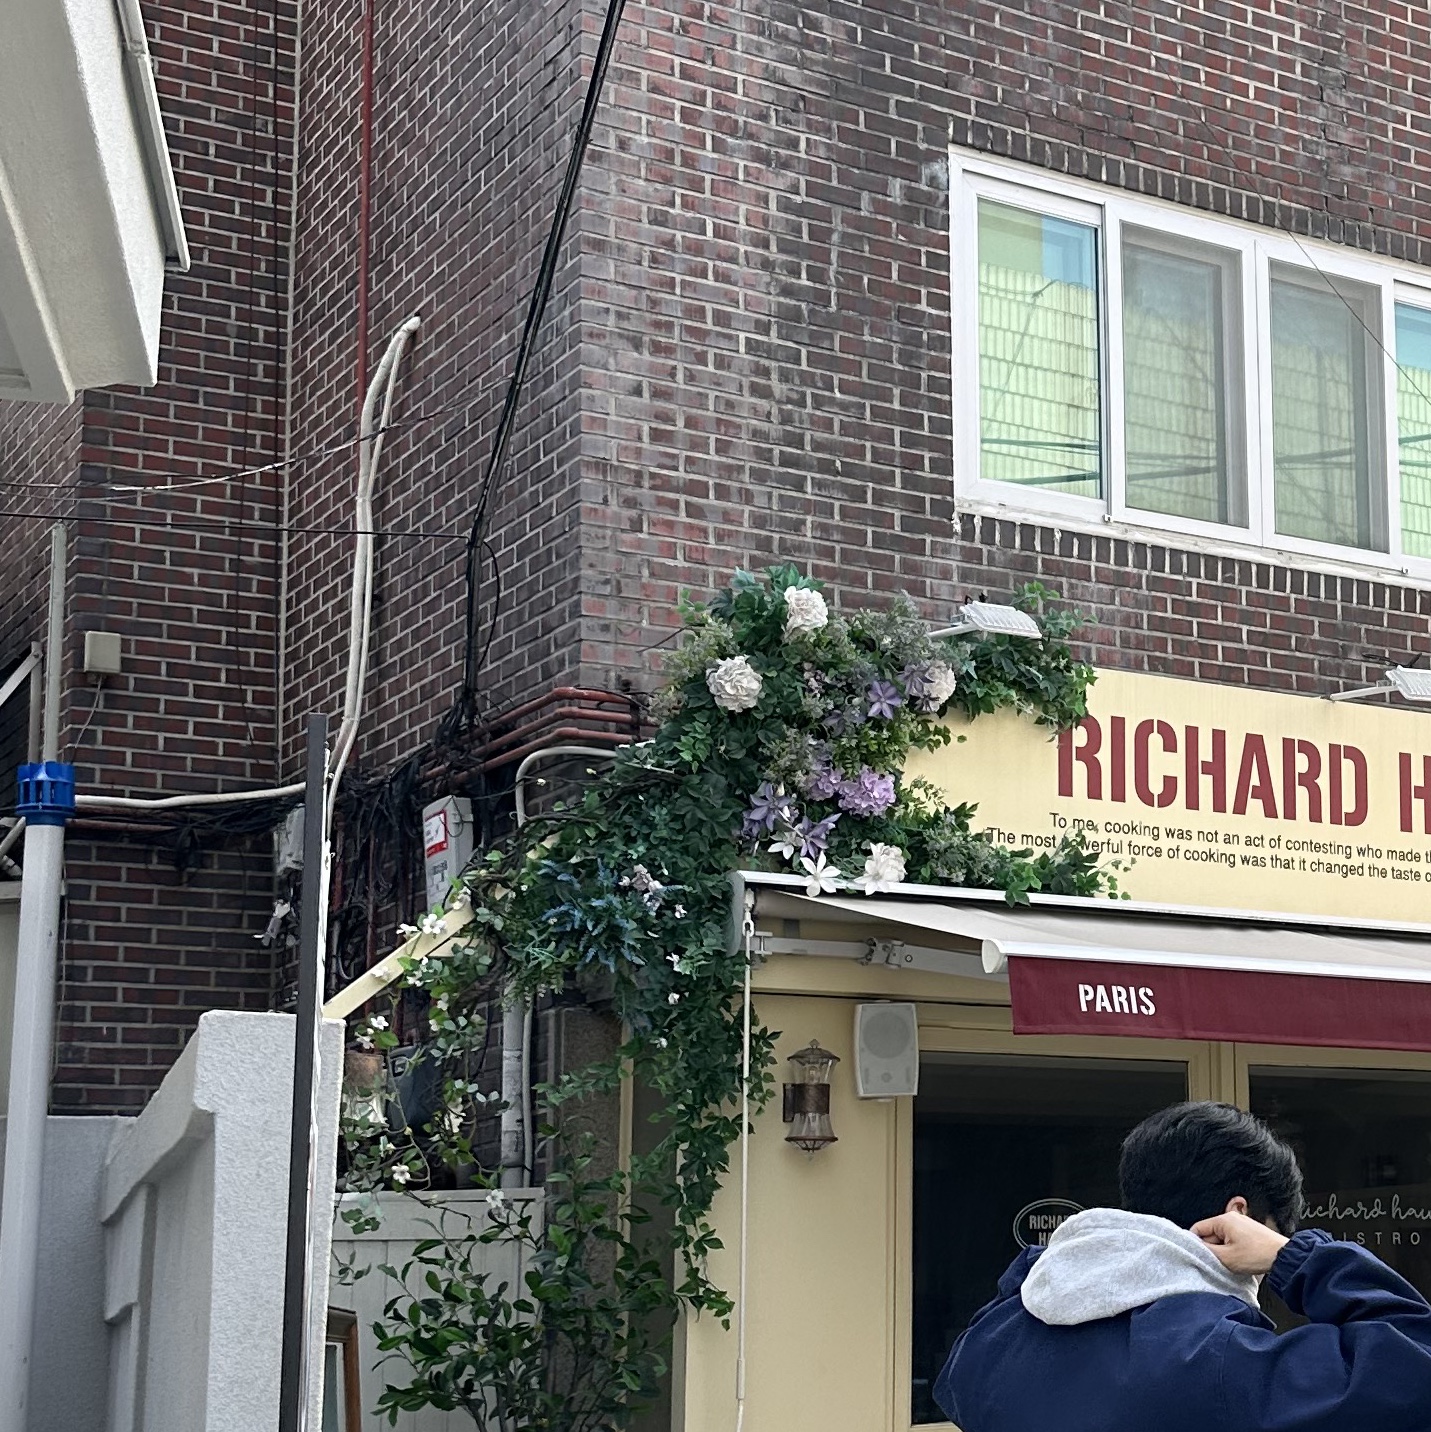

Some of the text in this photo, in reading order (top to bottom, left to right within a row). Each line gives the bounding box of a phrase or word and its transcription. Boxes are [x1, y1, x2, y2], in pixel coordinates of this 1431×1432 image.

[1056, 713, 1368, 829] RICHARD
[987, 826, 1016, 845] The
[1021, 832, 1057, 849] most
[1079, 836, 1124, 855] werful
[1127, 840, 1163, 858] force
[1167, 844, 1181, 860] of
[1184, 848, 1236, 868] cooking
[1240, 854, 1267, 868] was
[1270, 854, 1296, 871] that
[1299, 857, 1307, 872] it
[1310, 858, 1365, 879] changed
[1368, 863, 1388, 880] the
[1391, 865, 1421, 882] taste
[1049, 812, 1067, 829] To
[1104, 820, 1160, 841] cooking
[1165, 827, 1193, 841] was
[1197, 829, 1219, 844] not
[1223, 833, 1240, 846] an
[1244, 834, 1265, 849] act
[1269, 835, 1282, 850] of
[1285, 838, 1352, 860] contesting
[1356, 844, 1383, 860] who
[1387, 847, 1421, 863] made
[1078, 984, 1156, 1016] PARIS
[1029, 1215, 1068, 1230] RICHA
[1343, 1231, 1422, 1246] ISTRO
